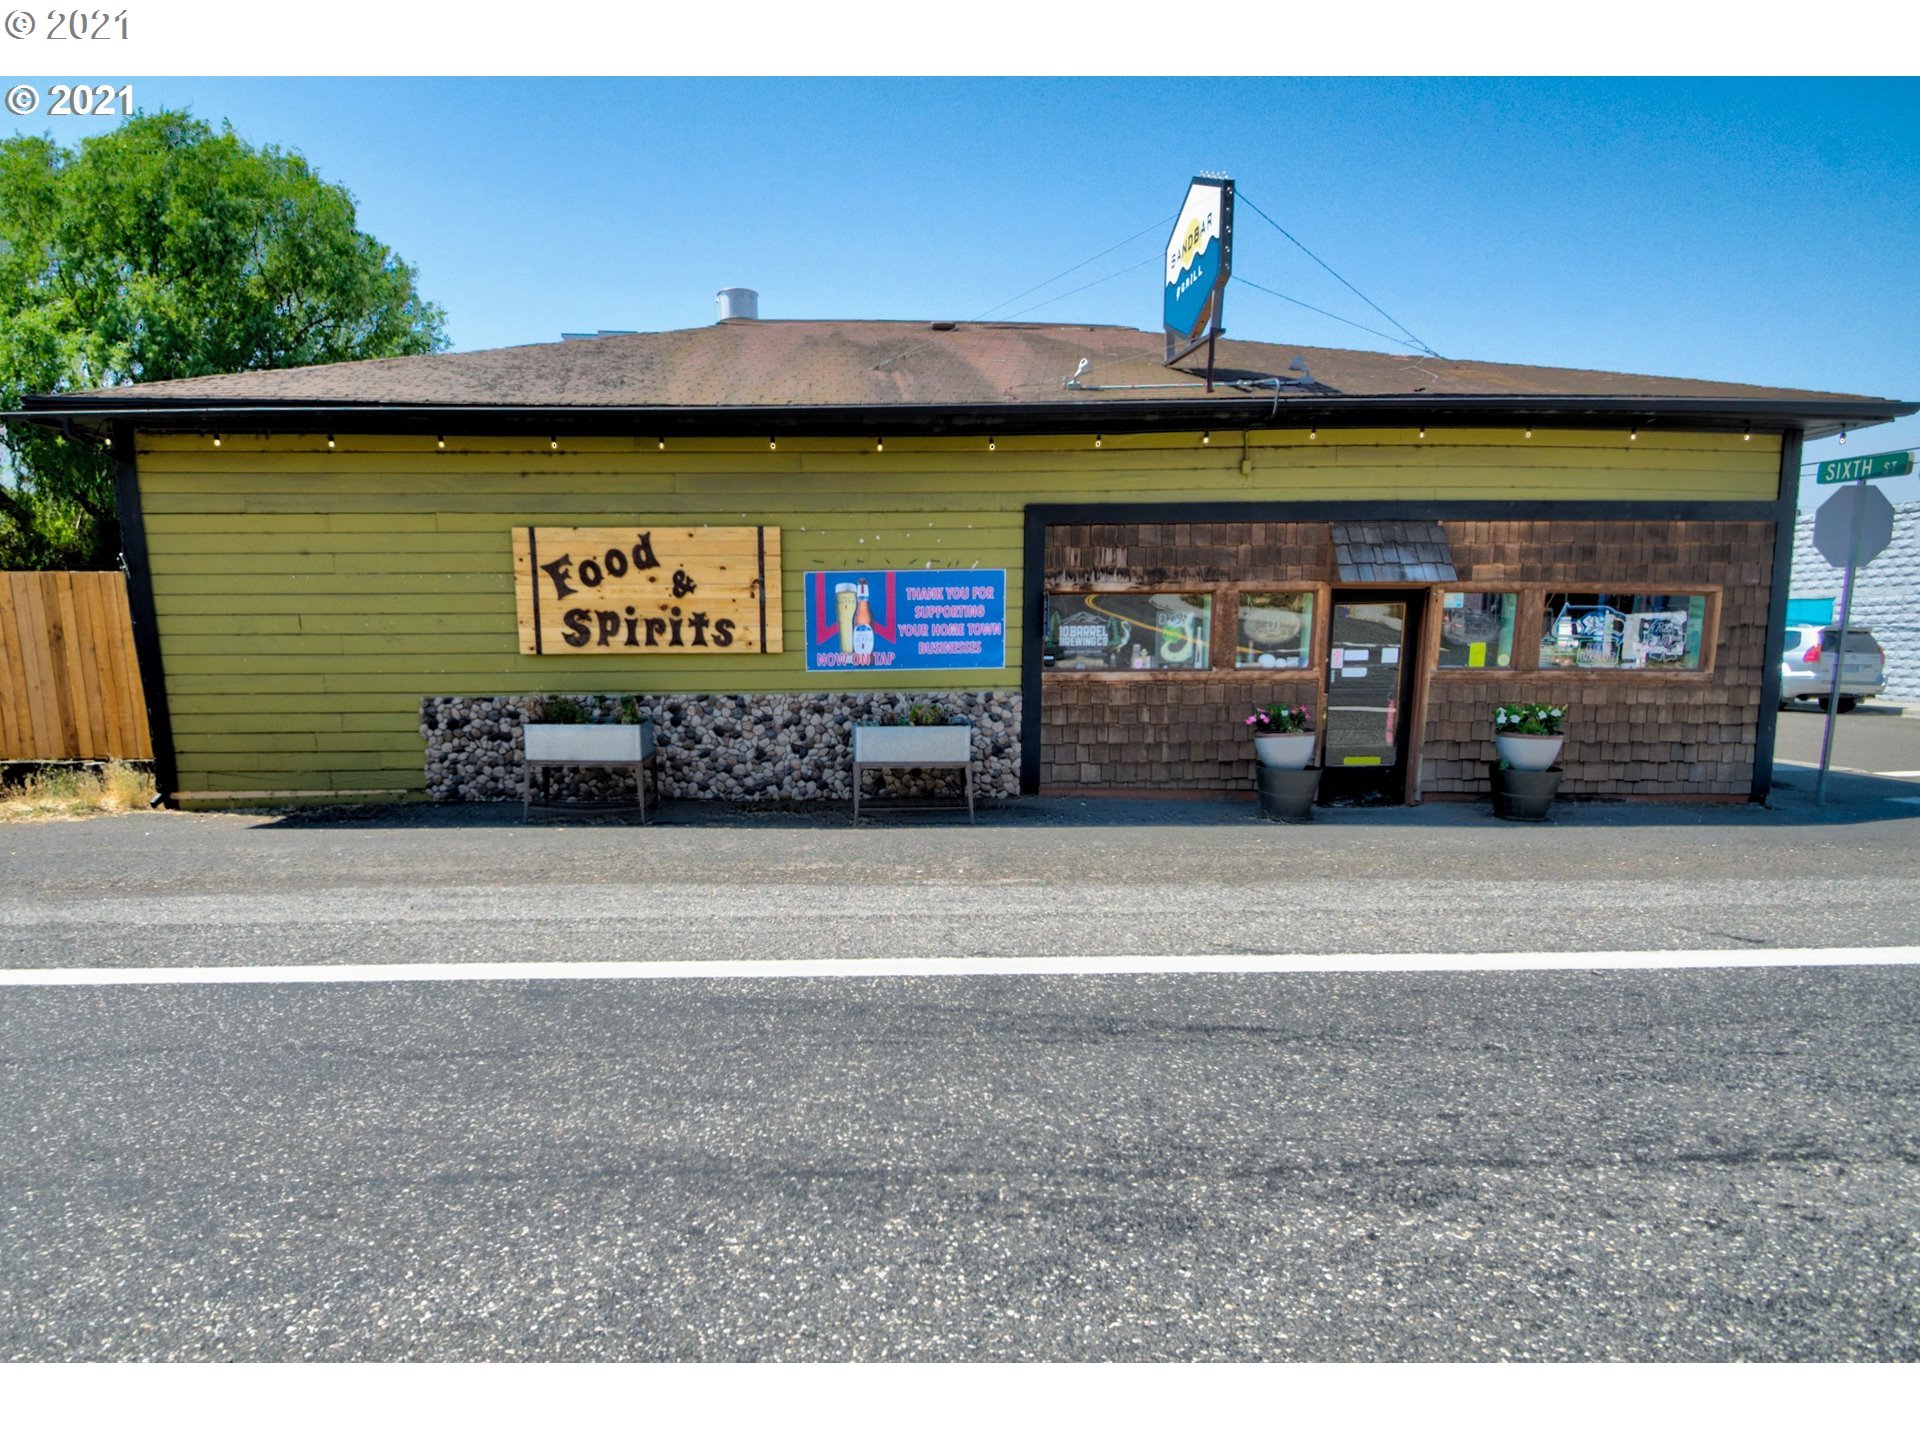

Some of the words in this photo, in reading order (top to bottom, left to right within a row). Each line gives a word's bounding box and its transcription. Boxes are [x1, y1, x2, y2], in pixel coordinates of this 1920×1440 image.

[1171, 212, 1213, 269] SANDBAR
[1181, 265, 1203, 293] GRILL
[1825, 458, 1873, 481] SIXTH
[1883, 460, 1898, 475] ST
[540, 531, 661, 601] Food
[672, 569, 697, 598] &
[906, 587, 944, 601] THANK
[945, 586, 970, 600] YOU
[972, 585, 995, 600] FOR
[914, 604, 986, 619] SUPPORTING
[561, 605, 736, 648] Spirits
[898, 623, 929, 637] YOUR
[931, 623, 965, 637] HOME
[967, 622, 1002, 637] TOWN
[817, 652, 848, 667] NOW
[851, 652, 872, 666] ON
[873, 651, 896, 666] TAP
[918, 641, 982, 655] BUSINESSES
